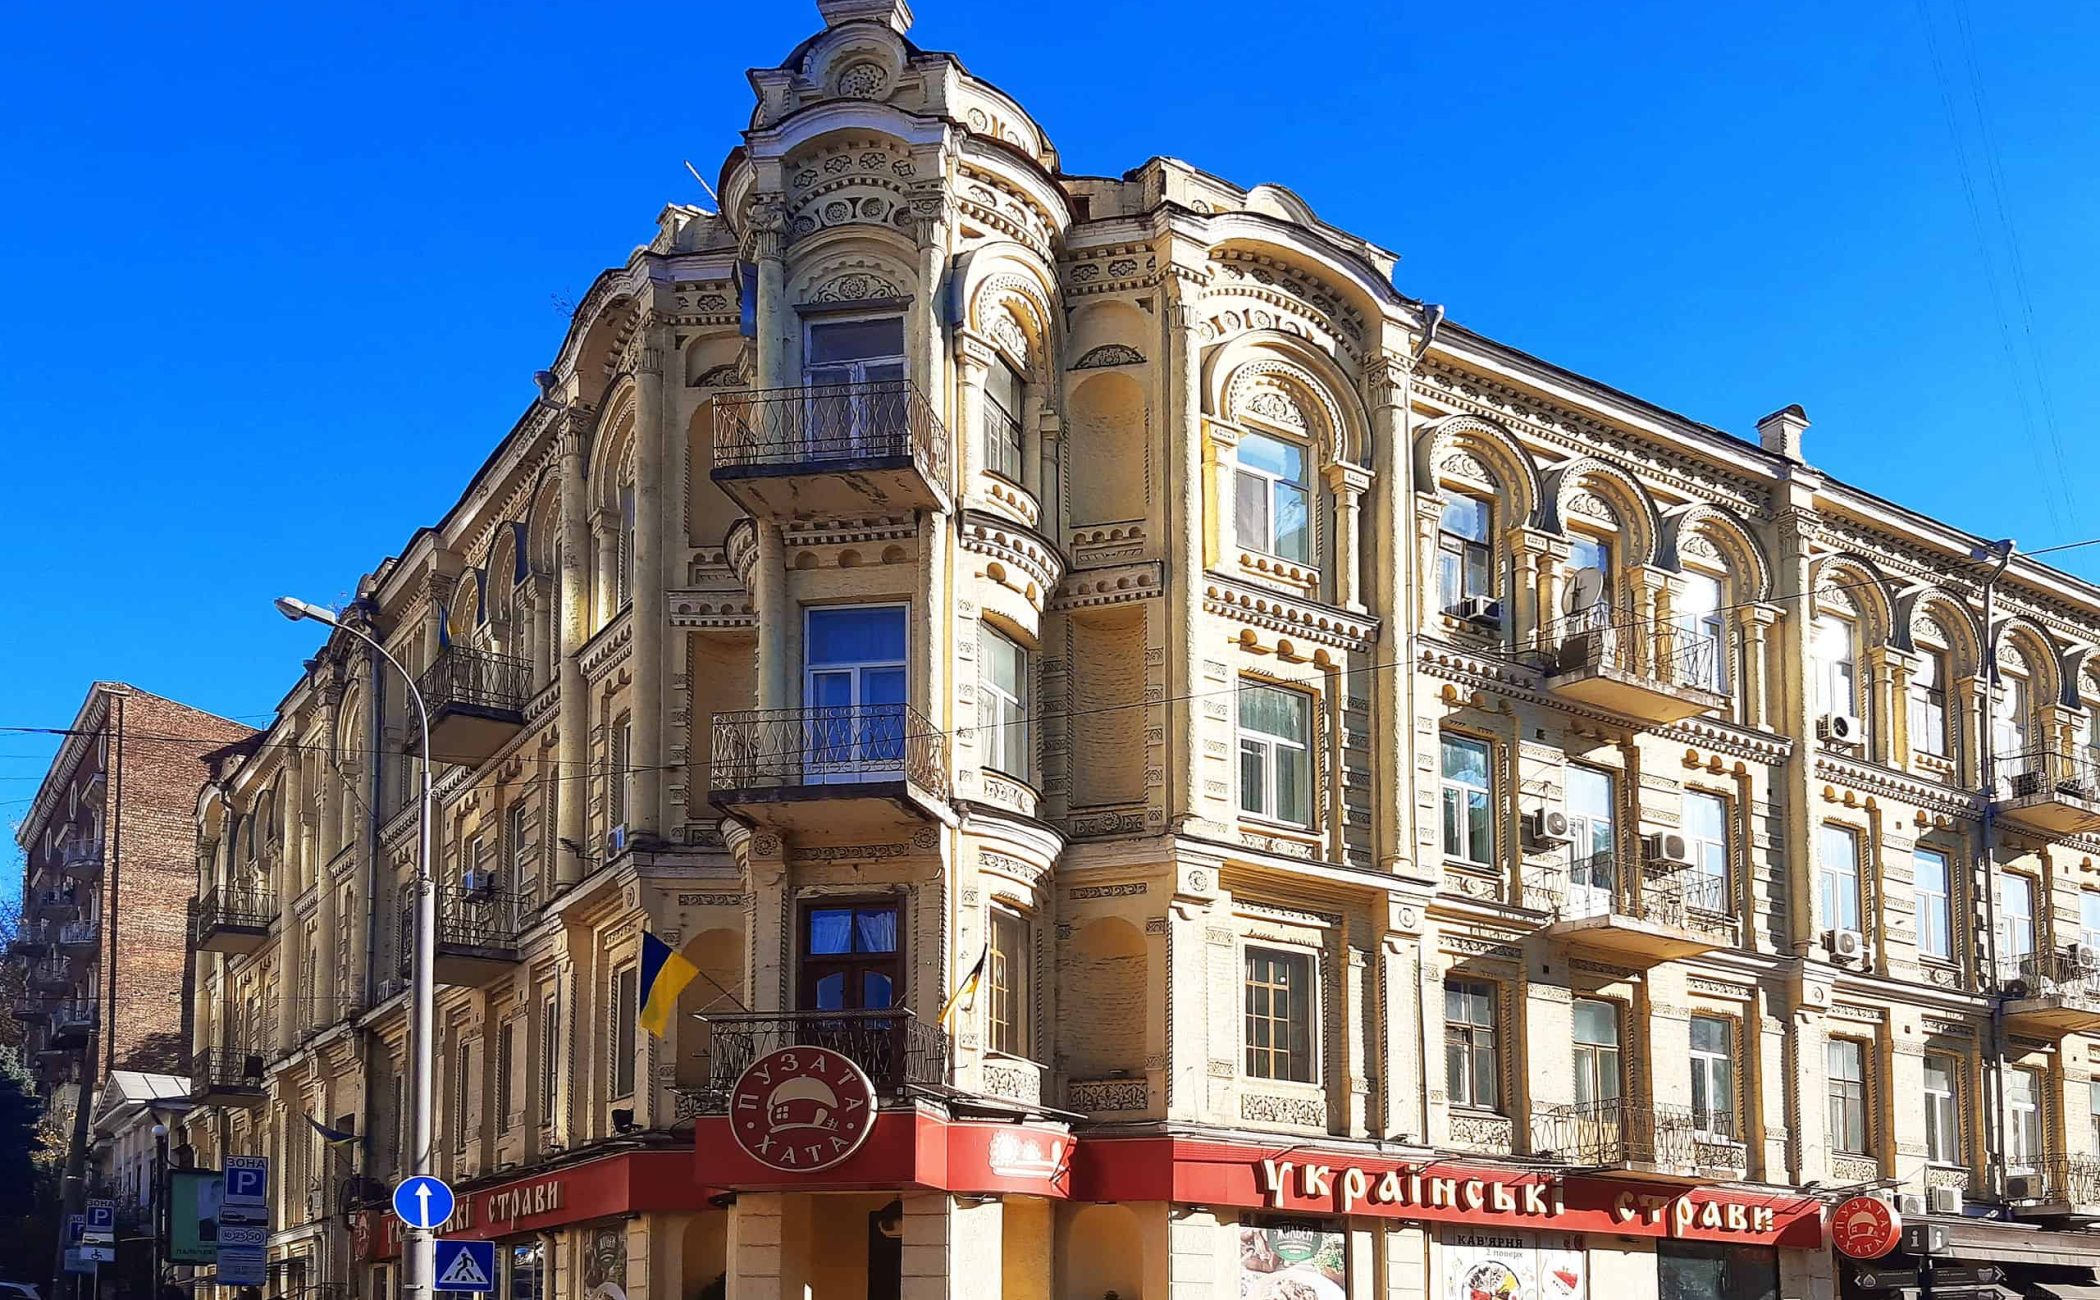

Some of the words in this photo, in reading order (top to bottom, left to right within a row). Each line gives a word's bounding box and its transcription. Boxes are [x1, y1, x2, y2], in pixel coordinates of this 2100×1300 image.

[738, 1053, 864, 1112] ПУЗАТА
[754, 1134, 850, 1164] ХАТА
[226, 1157, 266, 1169] ЗОНА
[237, 1171, 257, 1194] P
[1835, 1201, 1889, 1230] ПУЗАТА
[248, 1231, 261, 1241] 50
[1457, 1234, 1523, 1248] КАВ'ЯРНЯ
[1844, 1239, 1884, 1254] ХАТА
